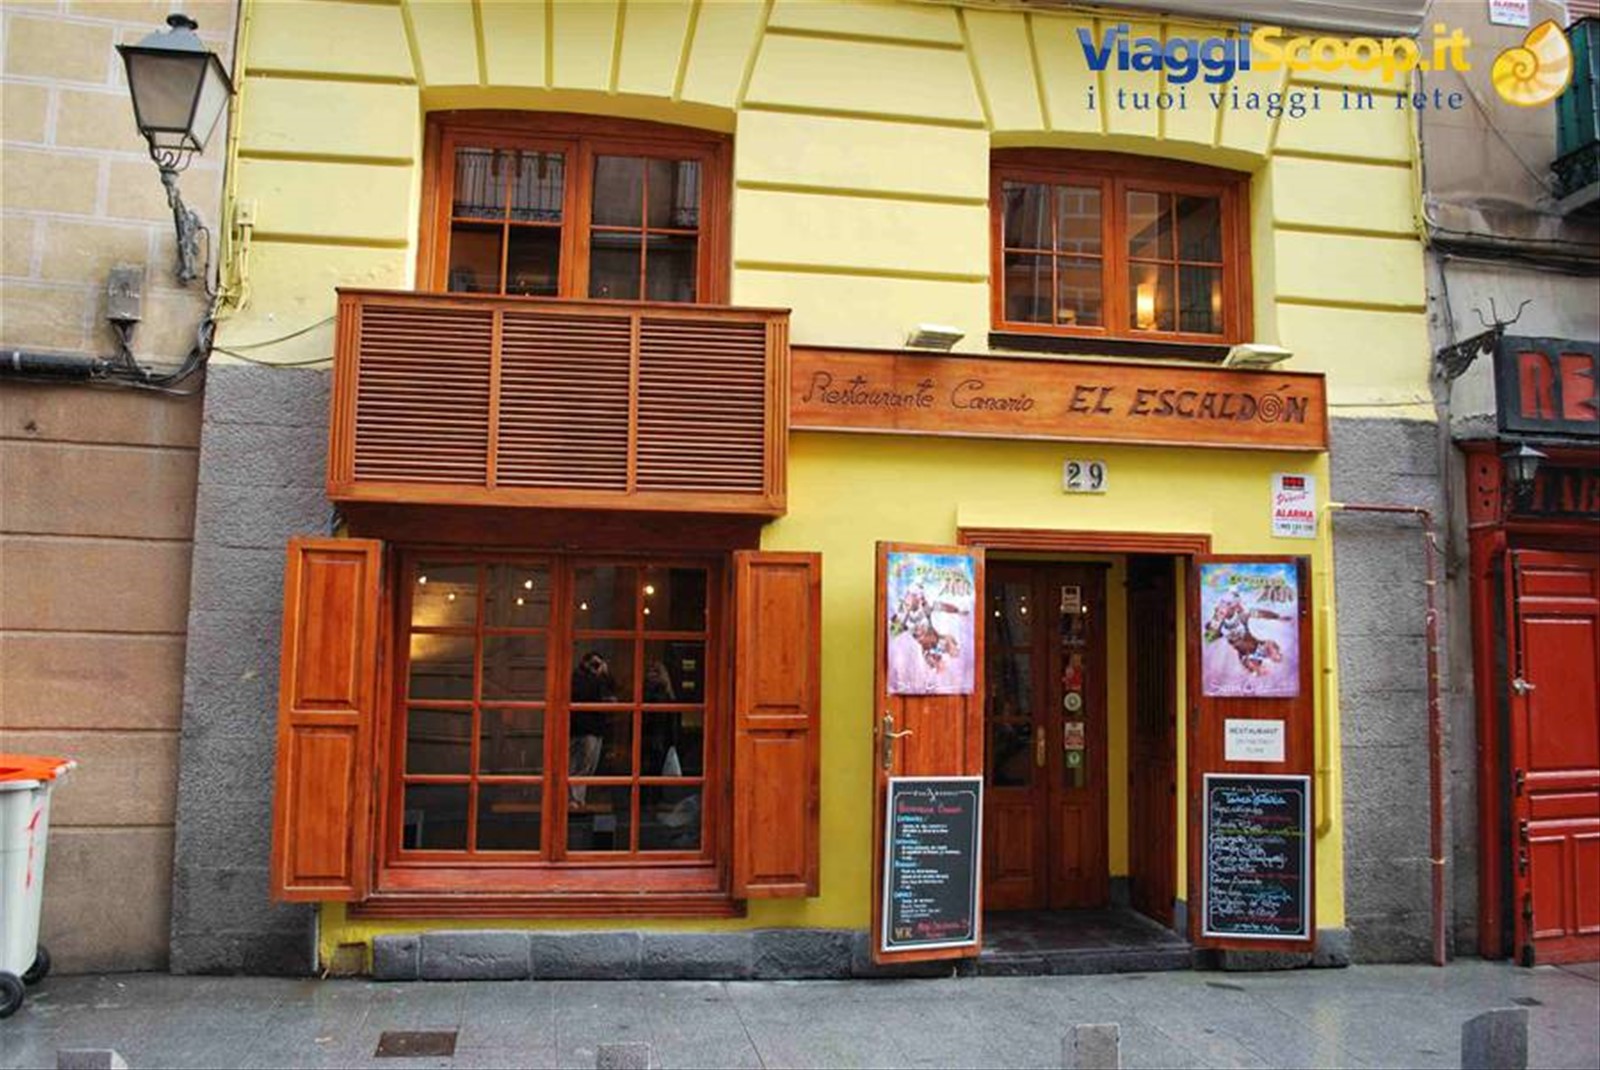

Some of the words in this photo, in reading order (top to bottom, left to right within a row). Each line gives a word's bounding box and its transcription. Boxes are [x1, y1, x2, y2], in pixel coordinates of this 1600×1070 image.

[802, 371, 935, 409] Restaurante
[950, 379, 1035, 412] Canario
[1067, 384, 1116, 414] EL
[1128, 384, 1309, 424] ESCALDÓN
[1067, 462, 1104, 490] 29
[1275, 509, 1314, 518] ALARMA
